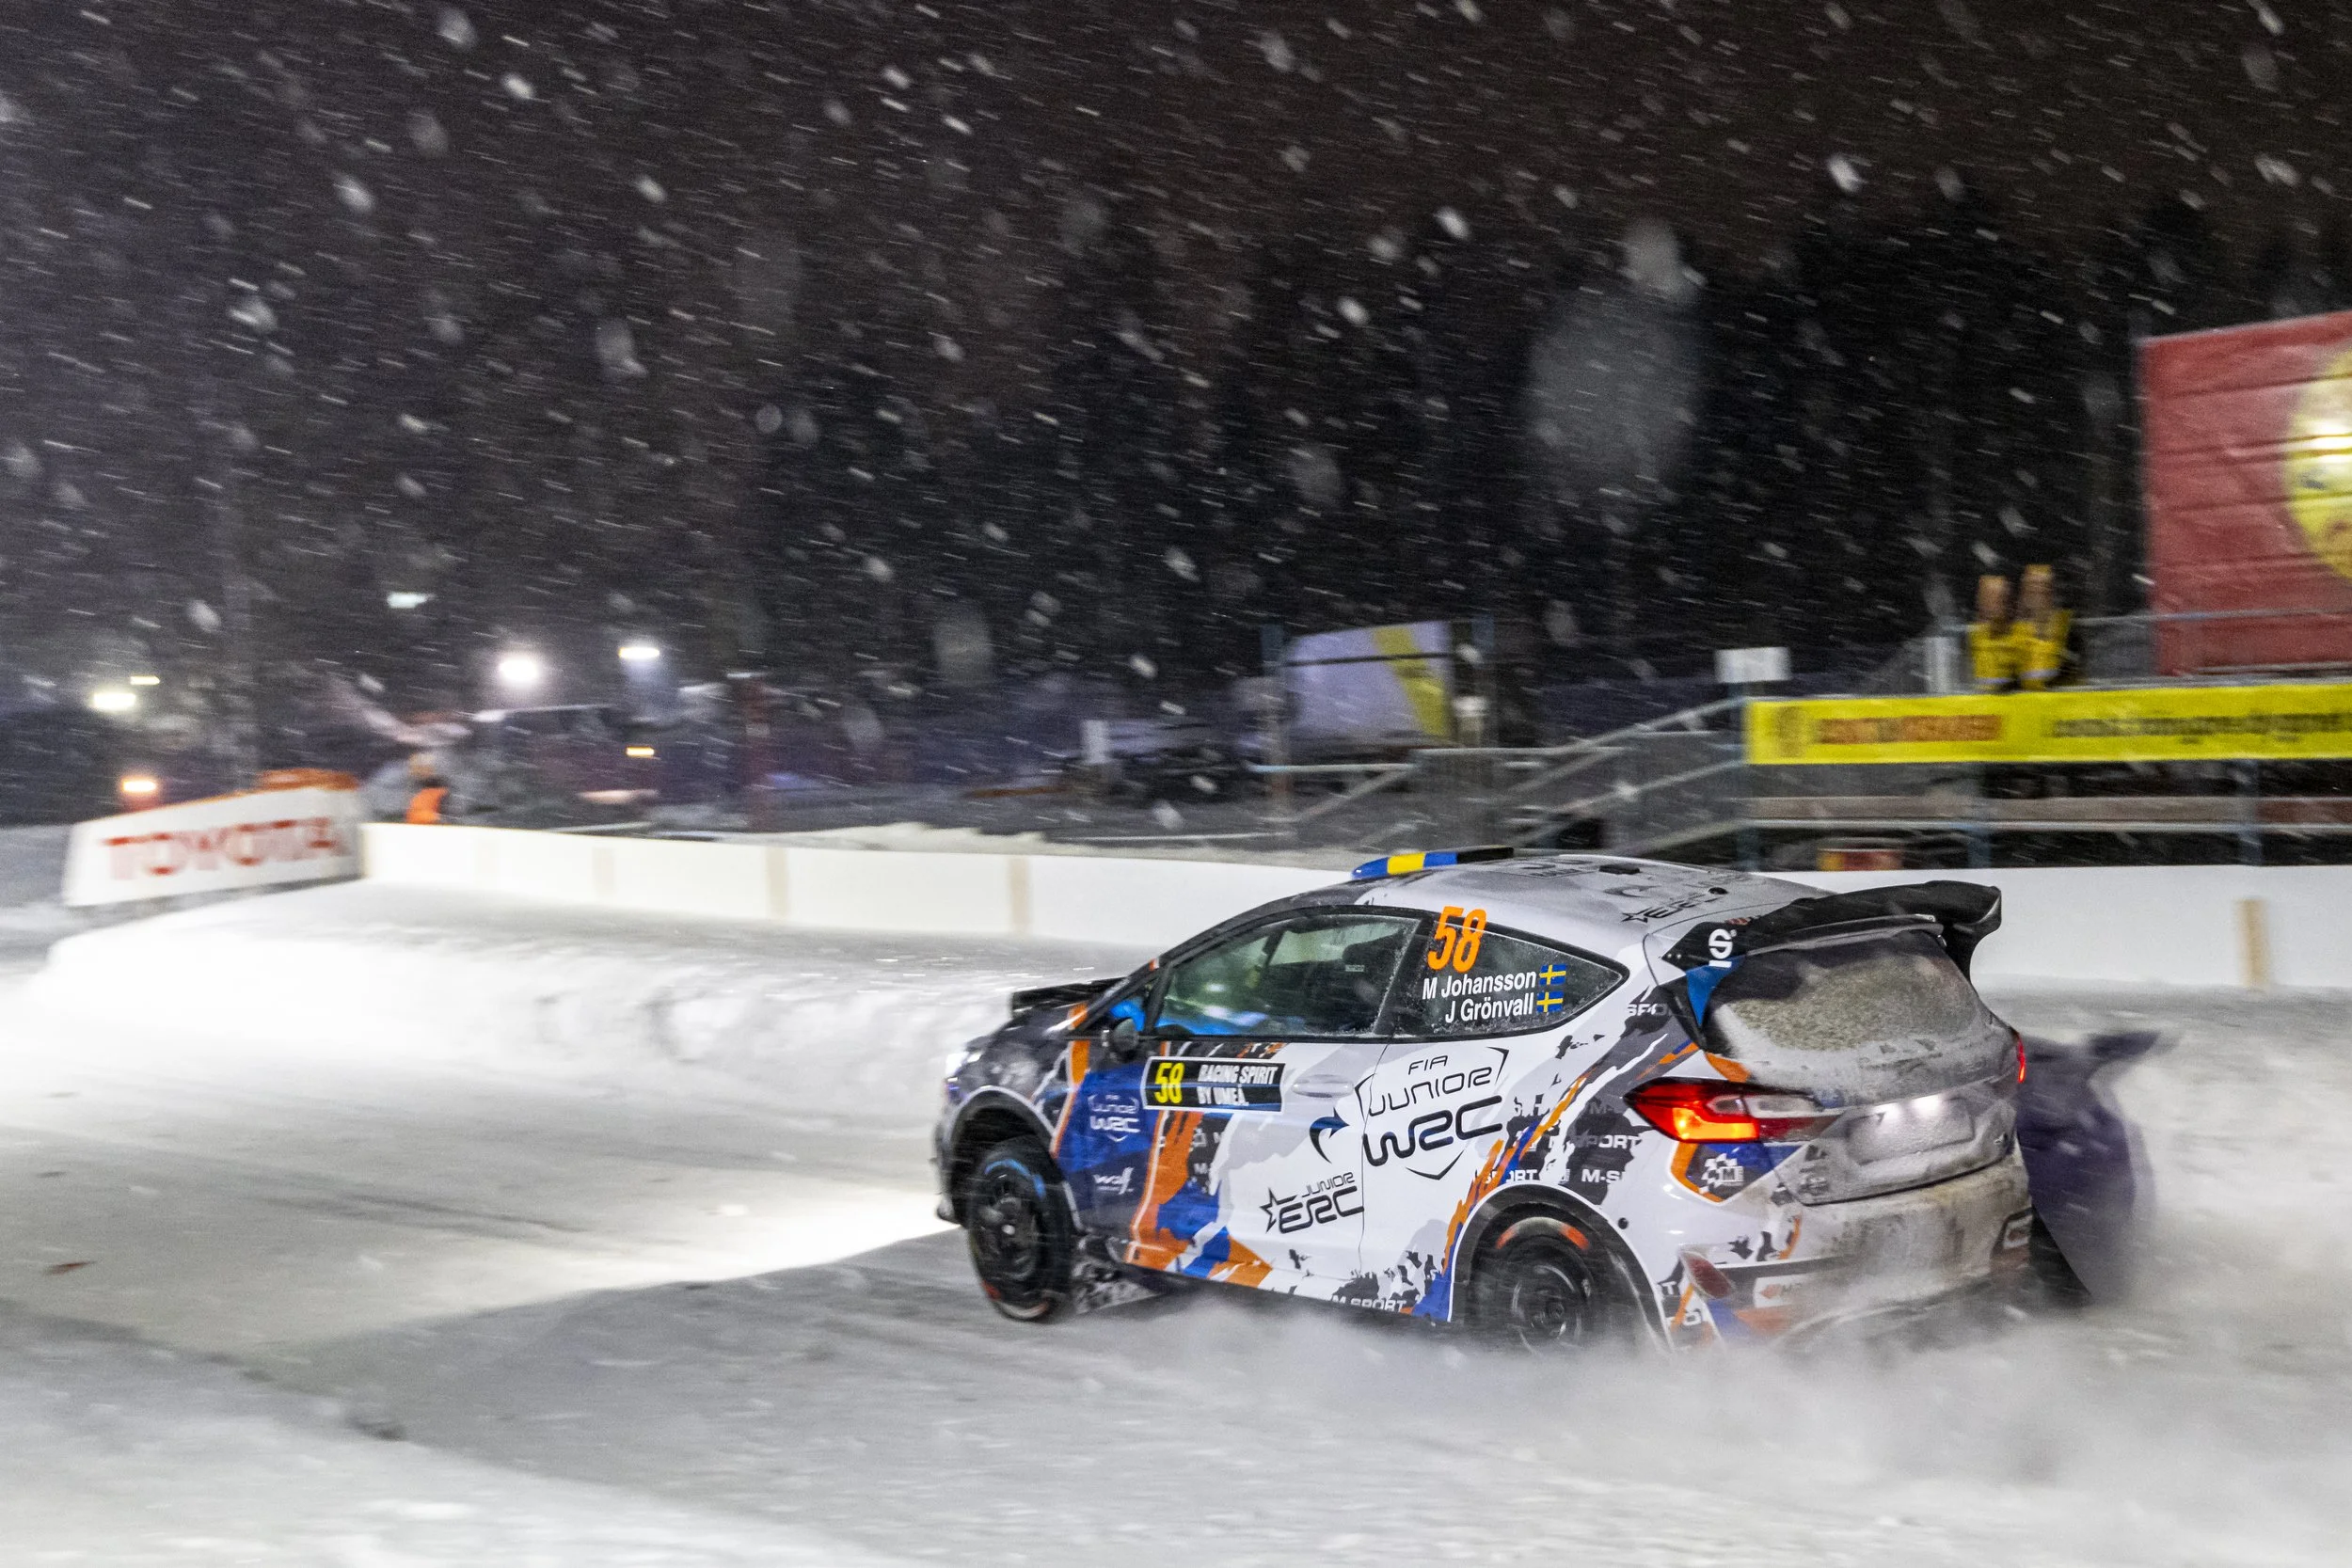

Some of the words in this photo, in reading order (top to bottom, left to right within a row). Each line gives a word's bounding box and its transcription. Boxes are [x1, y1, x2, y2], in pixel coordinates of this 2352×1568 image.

[105, 816, 350, 879] TOYOTA
[1427, 906, 1487, 973] 58
[1422, 976, 1438, 1000] M
[1440, 971, 1536, 998] Johansson
[1445, 1000, 1455, 1023] J
[1460, 991, 1534, 1022] Grönvall
[1198, 1064, 1240, 1083] RACING
[1239, 1066, 1279, 1084] SPIRIT
[1408, 1054, 1448, 1075] FIA
[1154, 1062, 1185, 1103] 58
[1197, 1085, 1213, 1104] BY
[1369, 1067, 1492, 1117] JUNIOR
[1089, 1115, 1141, 1133] WRC
[1362, 1095, 1502, 1166] WRC
[1301, 1171, 1356, 1198] JUNIOR
[1279, 1185, 1365, 1234] ERC
